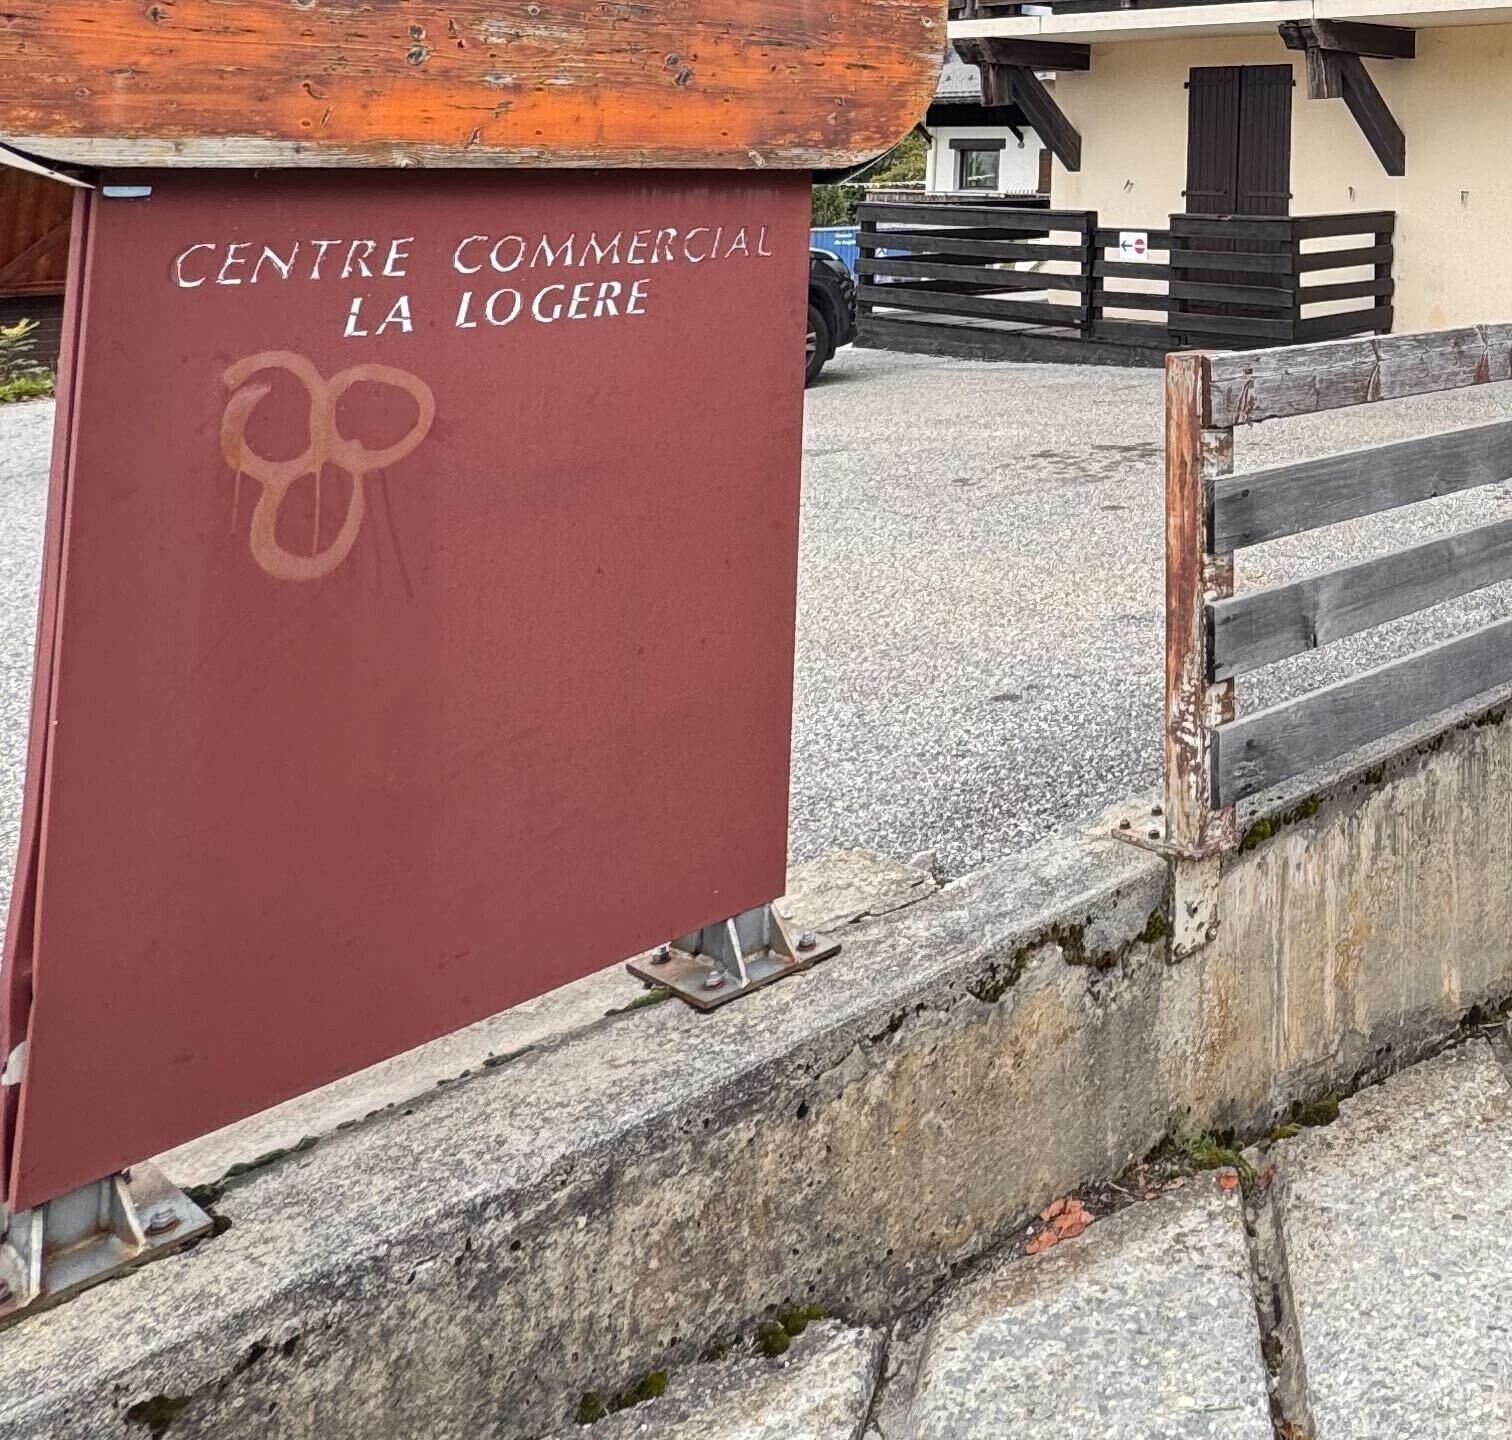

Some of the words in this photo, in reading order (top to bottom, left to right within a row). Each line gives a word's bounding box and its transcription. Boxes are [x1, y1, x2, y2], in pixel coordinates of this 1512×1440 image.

[174, 234, 415, 289] CENTRE
[452, 224, 774, 275] COMMERCIAL
[343, 295, 414, 339] LA
[454, 278, 652, 330] LOGERE
